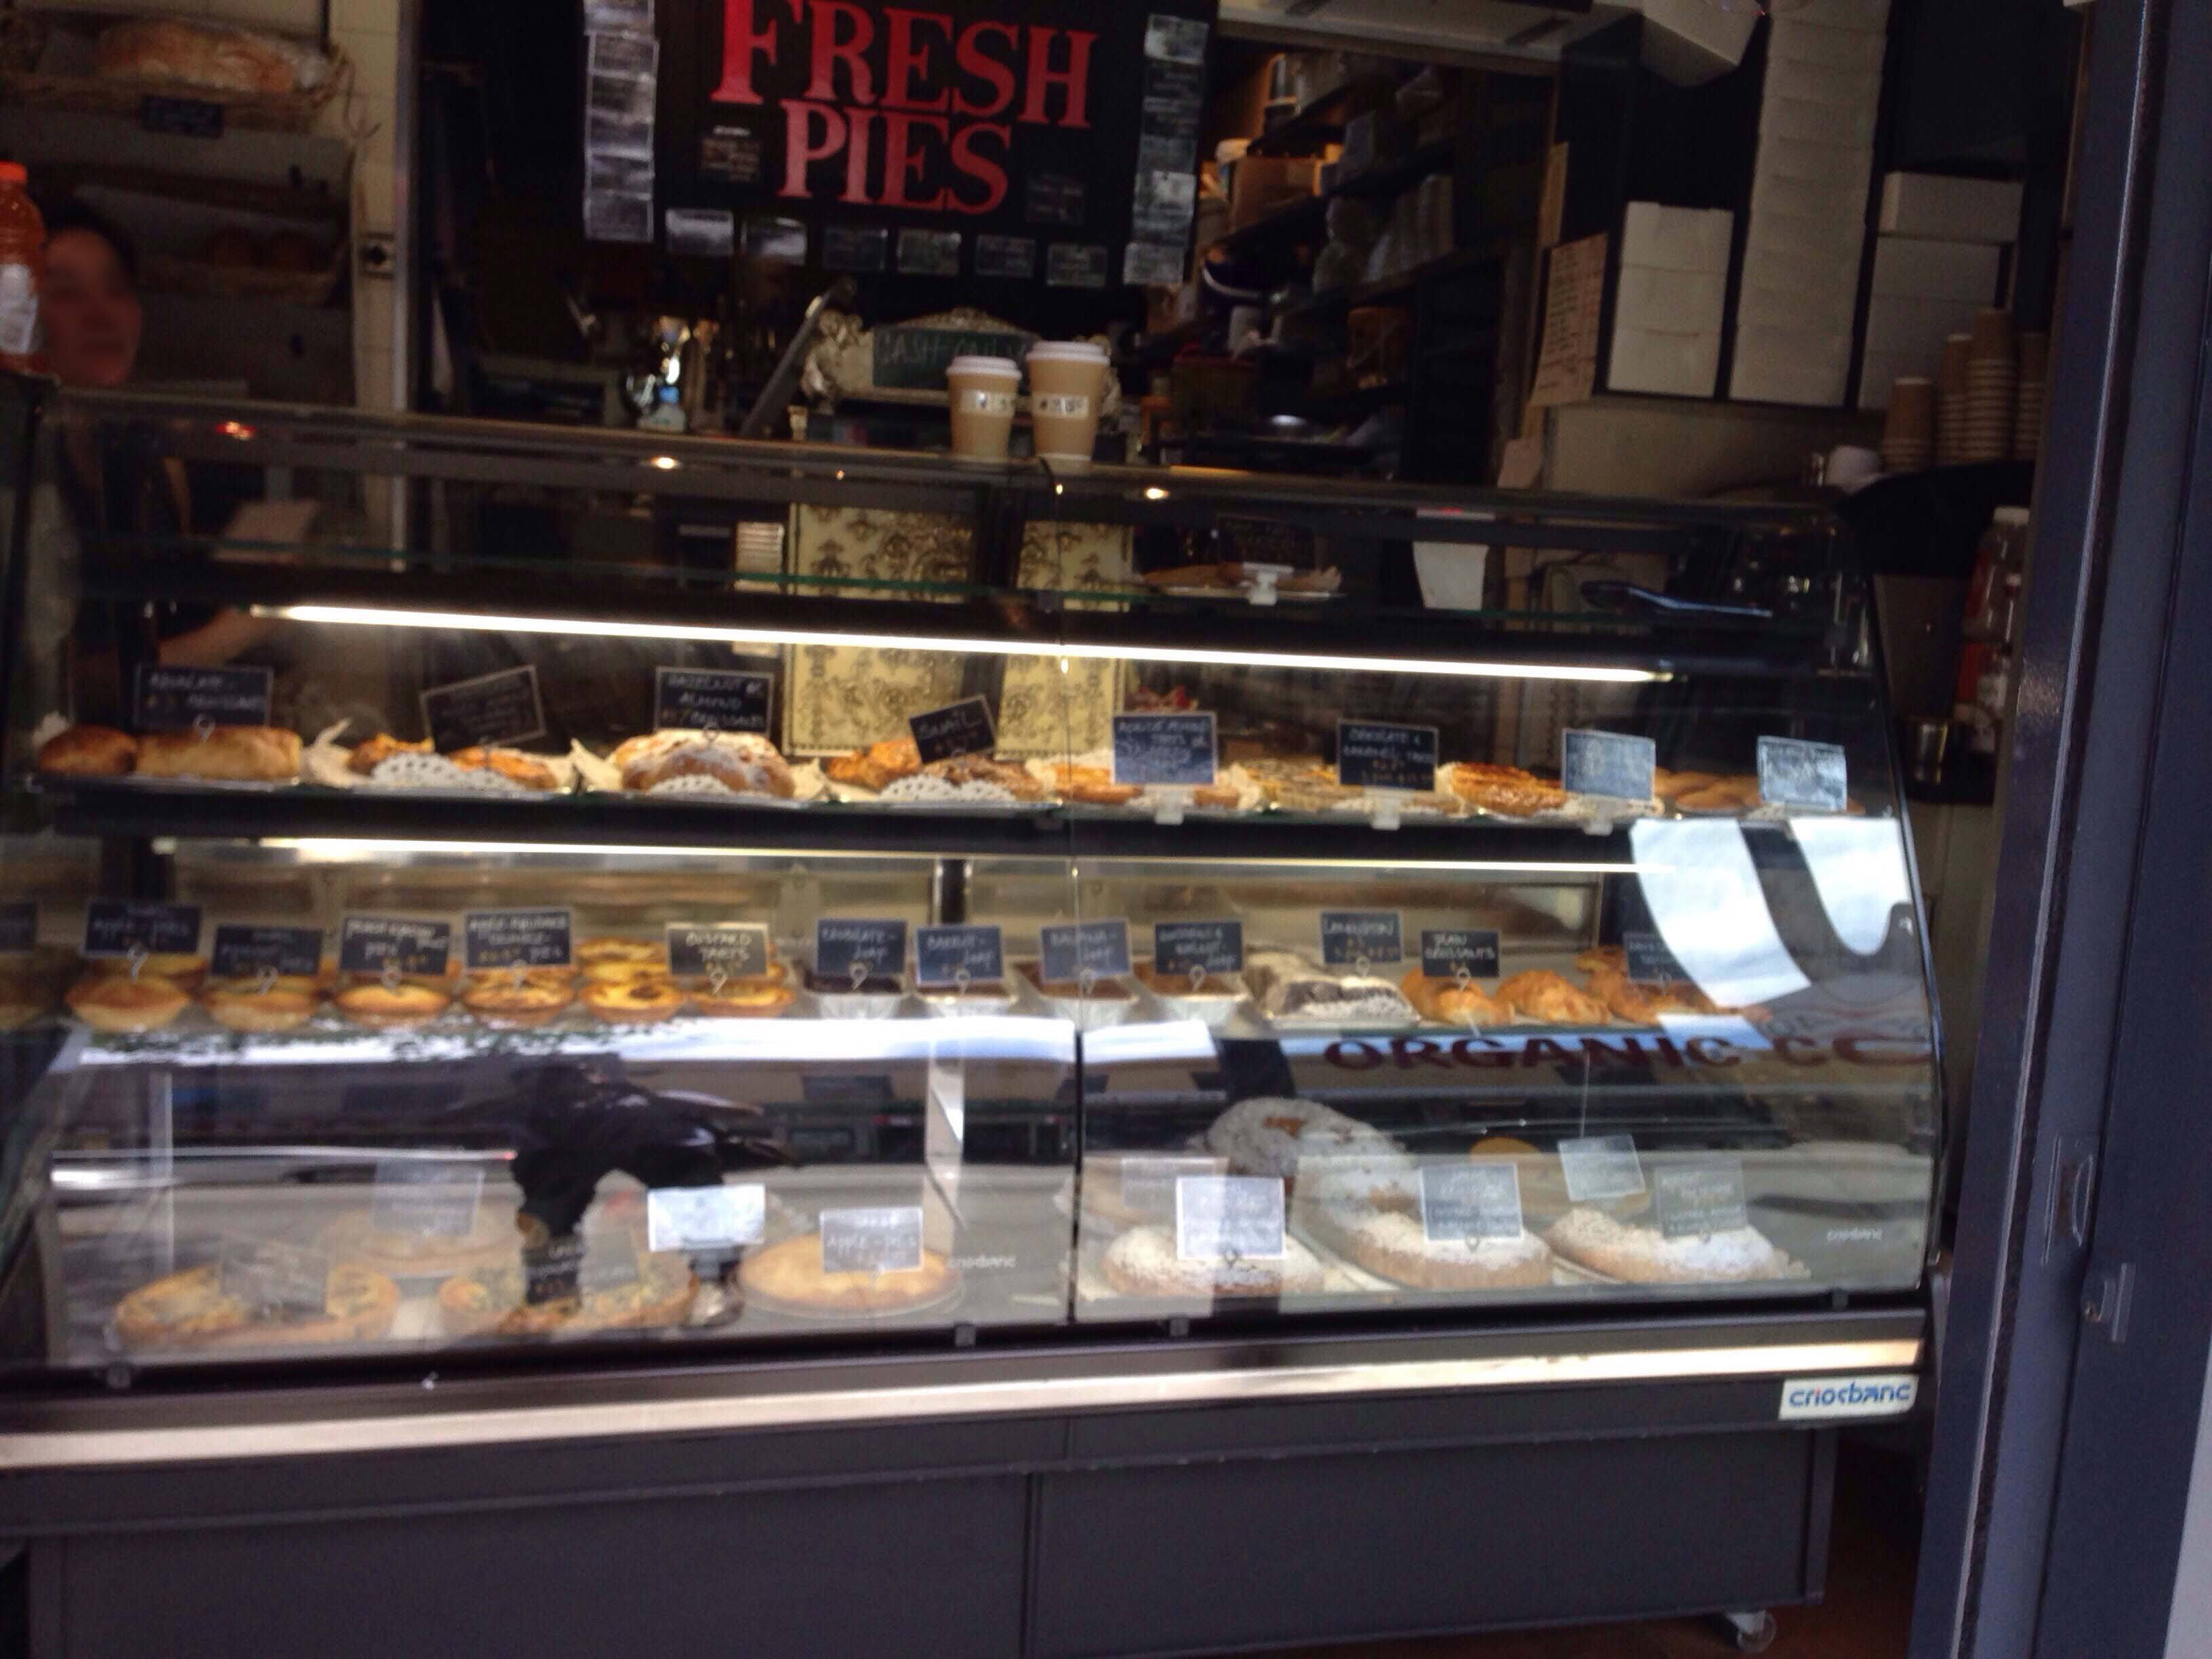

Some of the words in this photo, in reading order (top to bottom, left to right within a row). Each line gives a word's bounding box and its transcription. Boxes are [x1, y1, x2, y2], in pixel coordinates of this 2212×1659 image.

[710, 0, 1100, 129] FRESH
[778, 98, 1015, 215] PIES
[1323, 1034, 1742, 1070] ORGANIC
